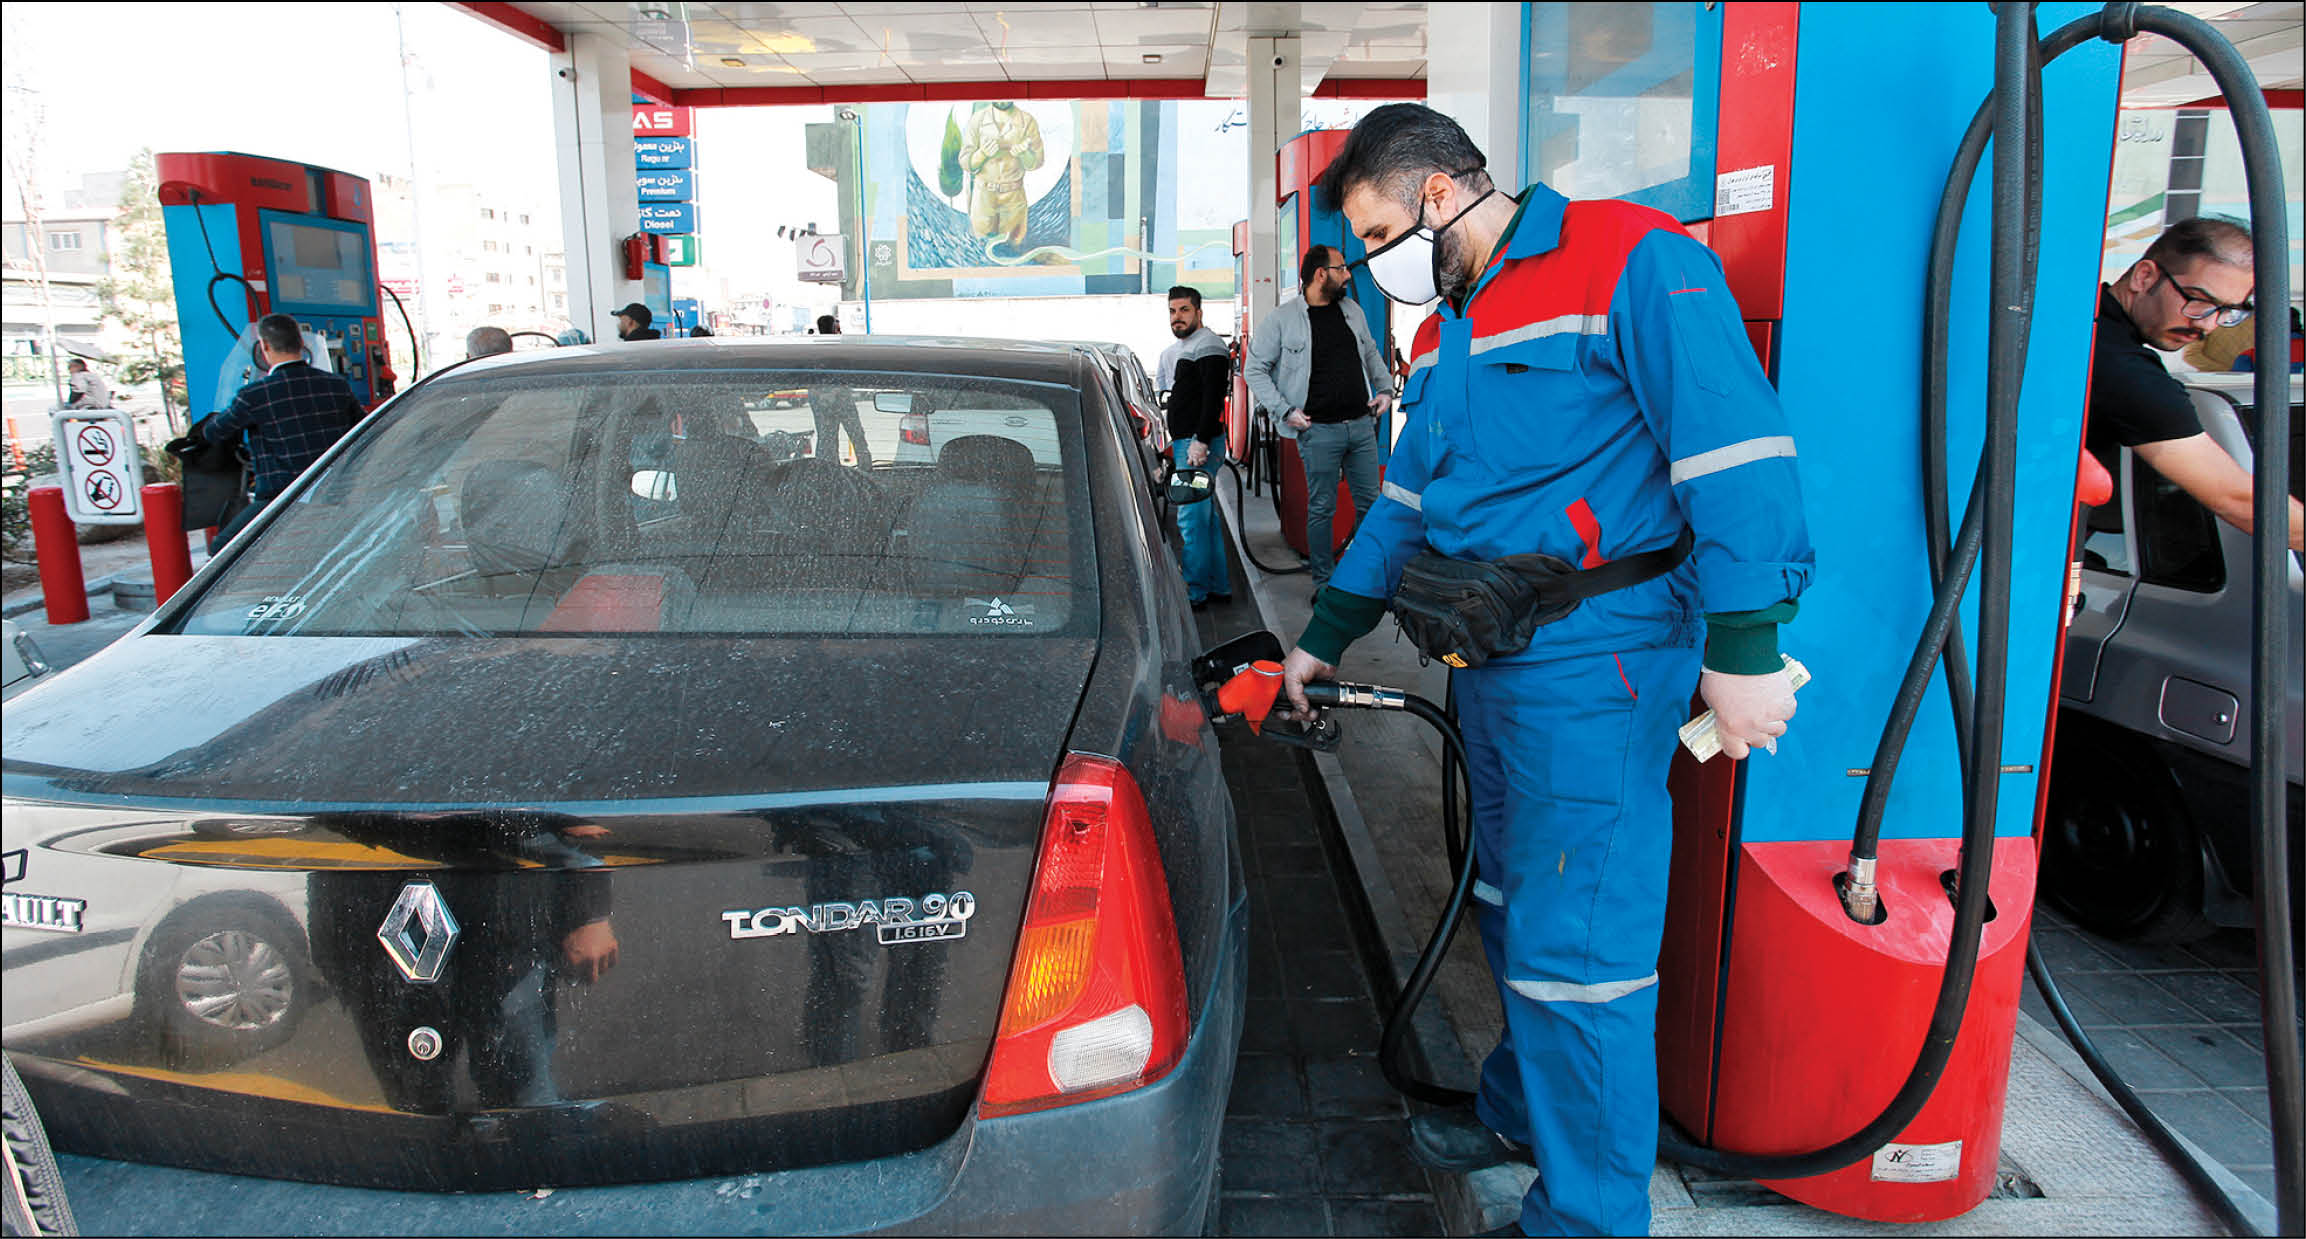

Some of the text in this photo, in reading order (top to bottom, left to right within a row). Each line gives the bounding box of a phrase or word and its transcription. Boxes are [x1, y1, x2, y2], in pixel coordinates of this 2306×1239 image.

[658, 141, 685, 153] بنزین
[641, 187, 676, 196] Premium
[644, 220, 674, 230] Diesel
[721, 891, 976, 939] TONDAR 90
